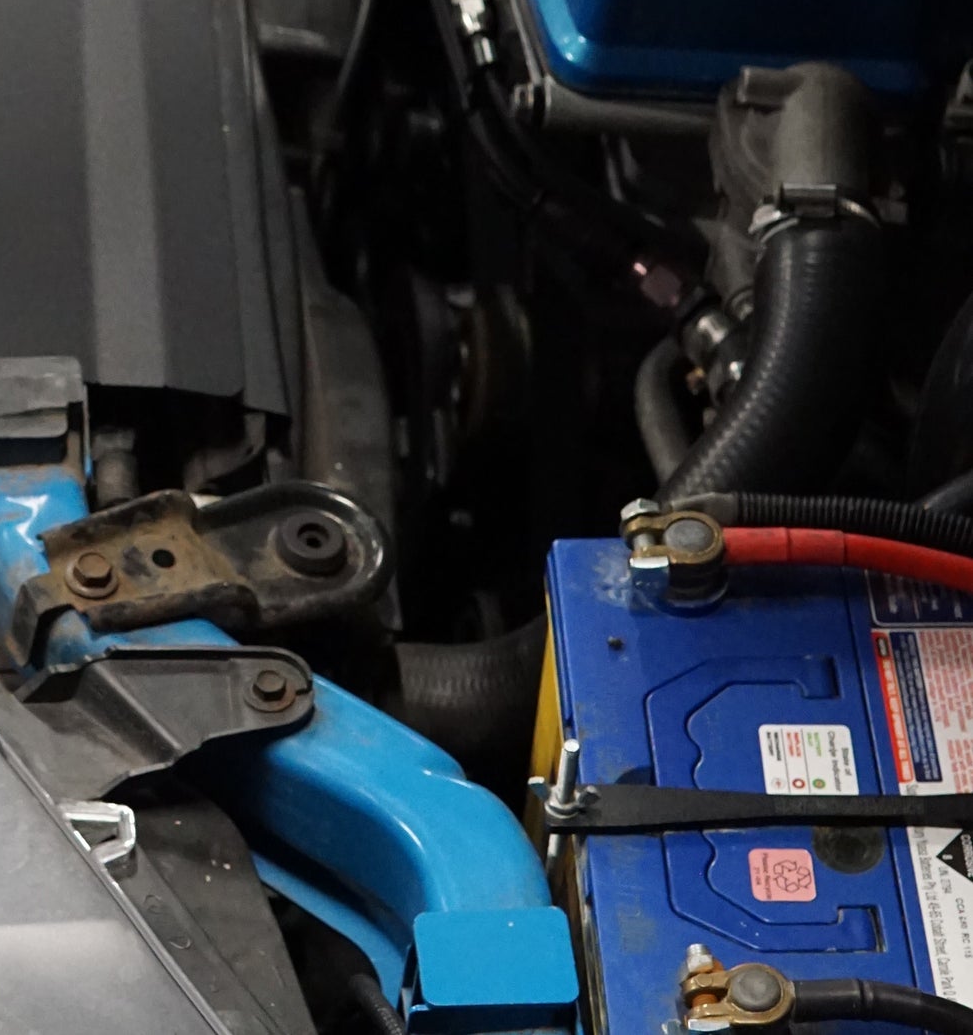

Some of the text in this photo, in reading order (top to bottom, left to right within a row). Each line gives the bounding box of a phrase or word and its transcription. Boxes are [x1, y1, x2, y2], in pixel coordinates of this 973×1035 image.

[828, 731, 842, 792] Charge Indicator
[955, 897, 965, 914] CCA
